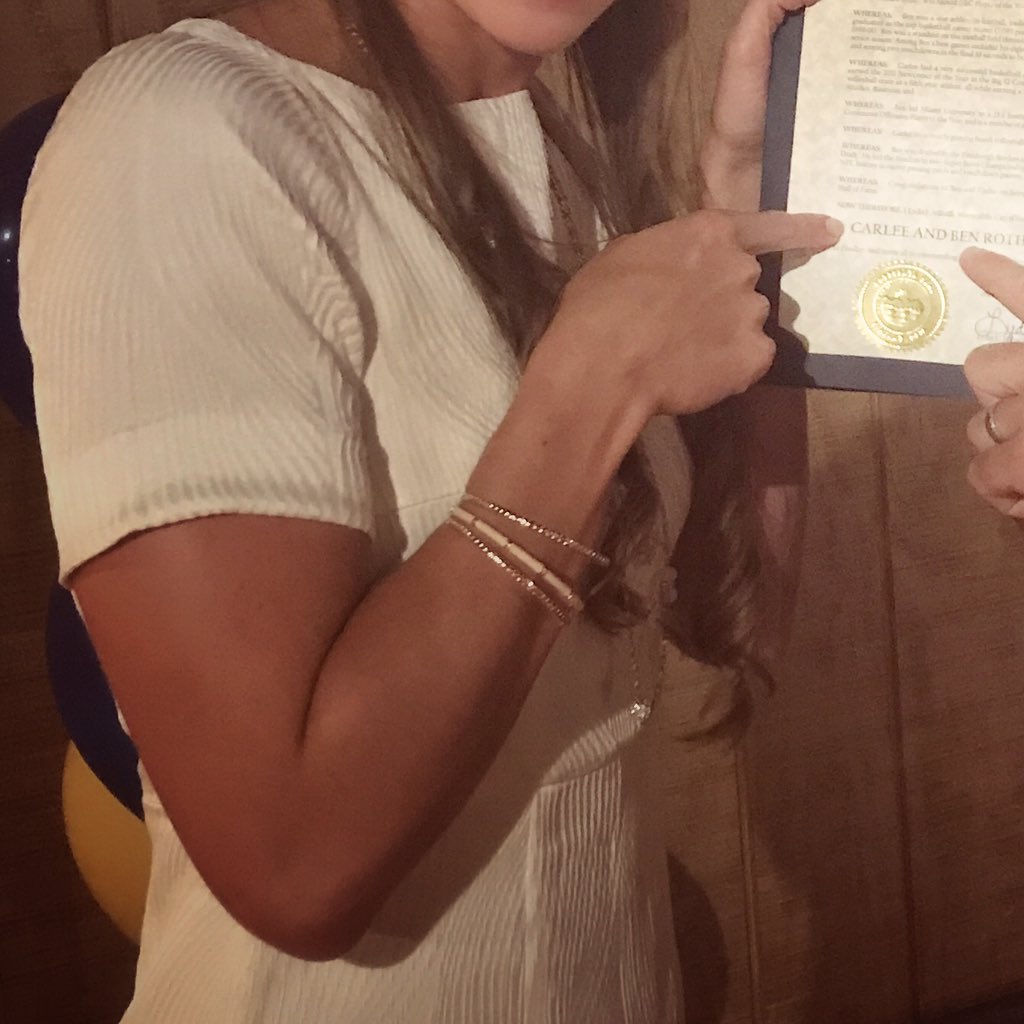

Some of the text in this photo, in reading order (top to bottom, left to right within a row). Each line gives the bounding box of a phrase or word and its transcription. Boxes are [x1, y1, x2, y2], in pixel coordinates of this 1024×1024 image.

[850, 220, 909, 238] CARLEE
[913, 226, 948, 241] AND
[950, 229, 980, 243] BEN
